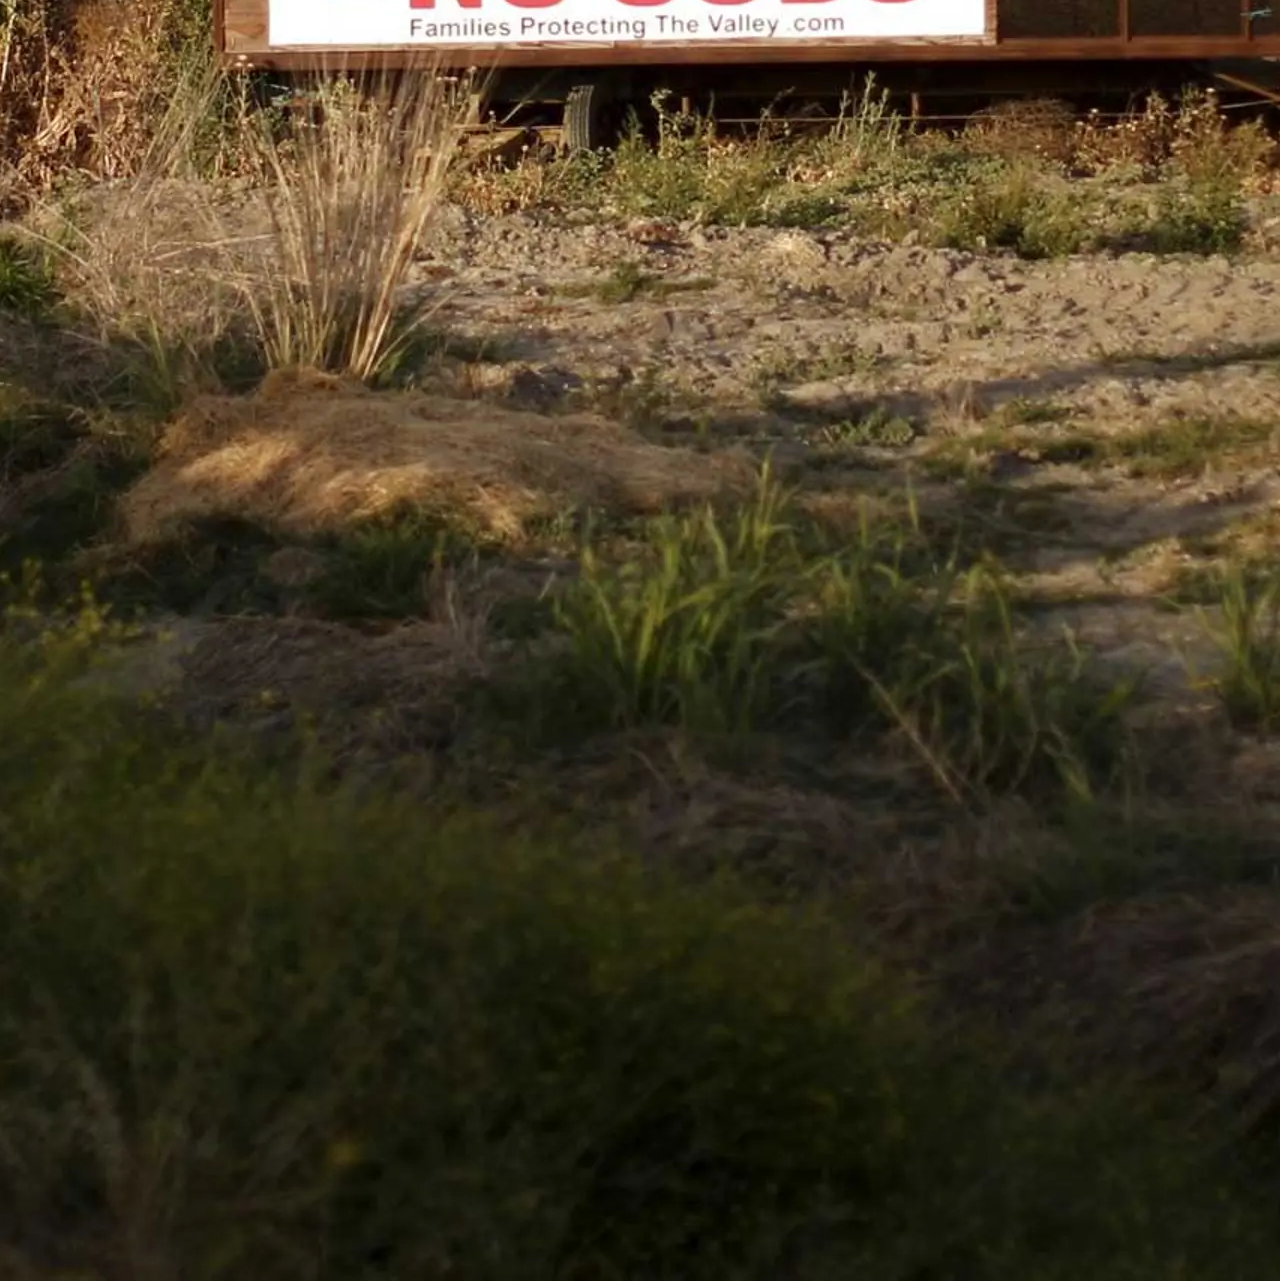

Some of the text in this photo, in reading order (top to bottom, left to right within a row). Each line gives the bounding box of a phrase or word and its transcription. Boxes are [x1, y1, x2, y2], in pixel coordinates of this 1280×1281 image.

[410, 17, 511, 38] Families
[521, 15, 646, 41] Protecting
[656, 14, 700, 34] The
[707, 12, 780, 39] Valley
